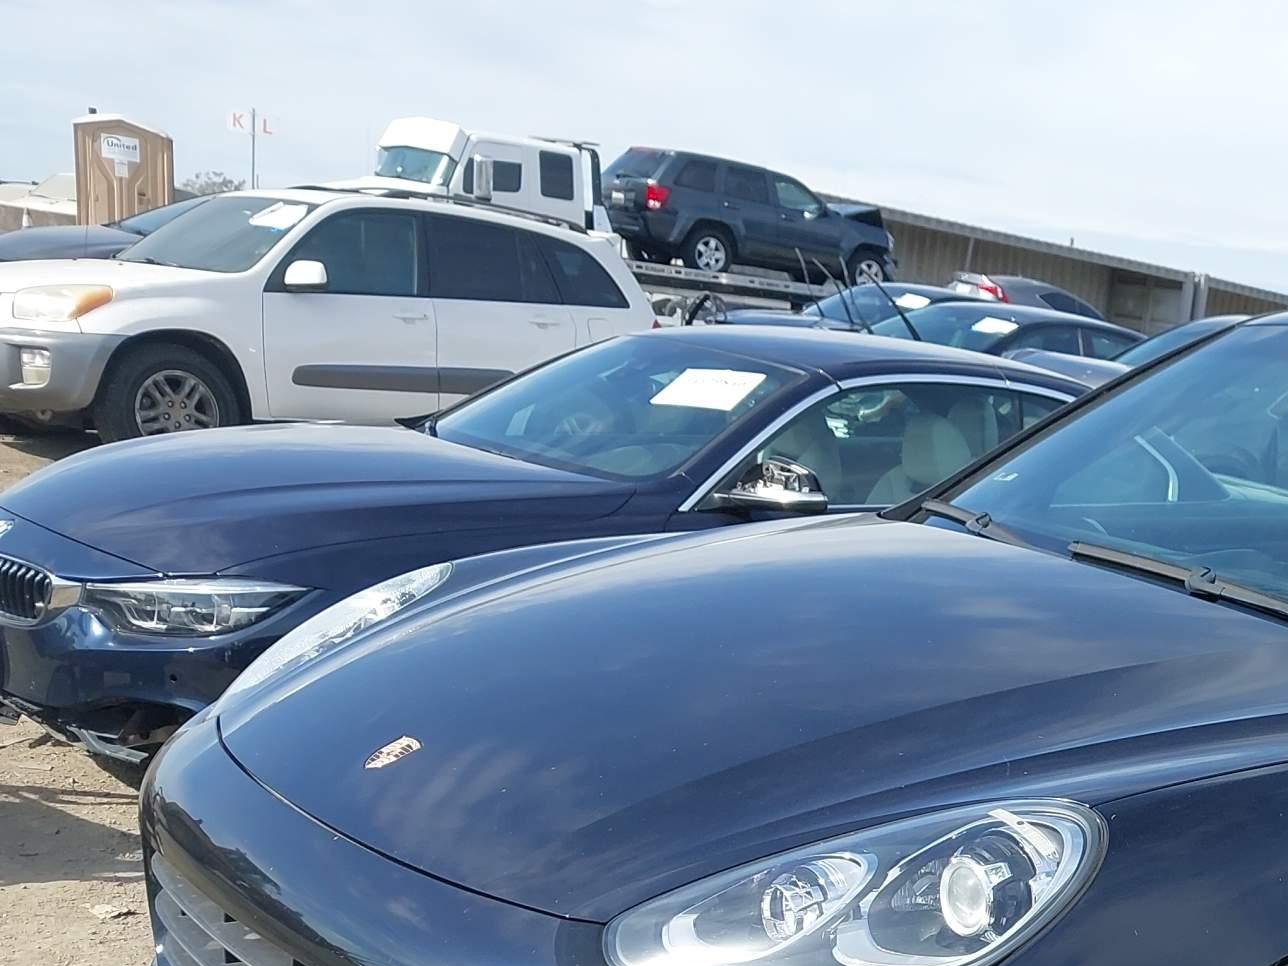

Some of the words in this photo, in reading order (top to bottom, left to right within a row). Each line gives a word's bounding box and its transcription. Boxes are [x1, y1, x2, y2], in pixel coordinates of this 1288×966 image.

[232, 111, 245, 129] K
[263, 117, 273, 135] L
[106, 139, 137, 151] United
